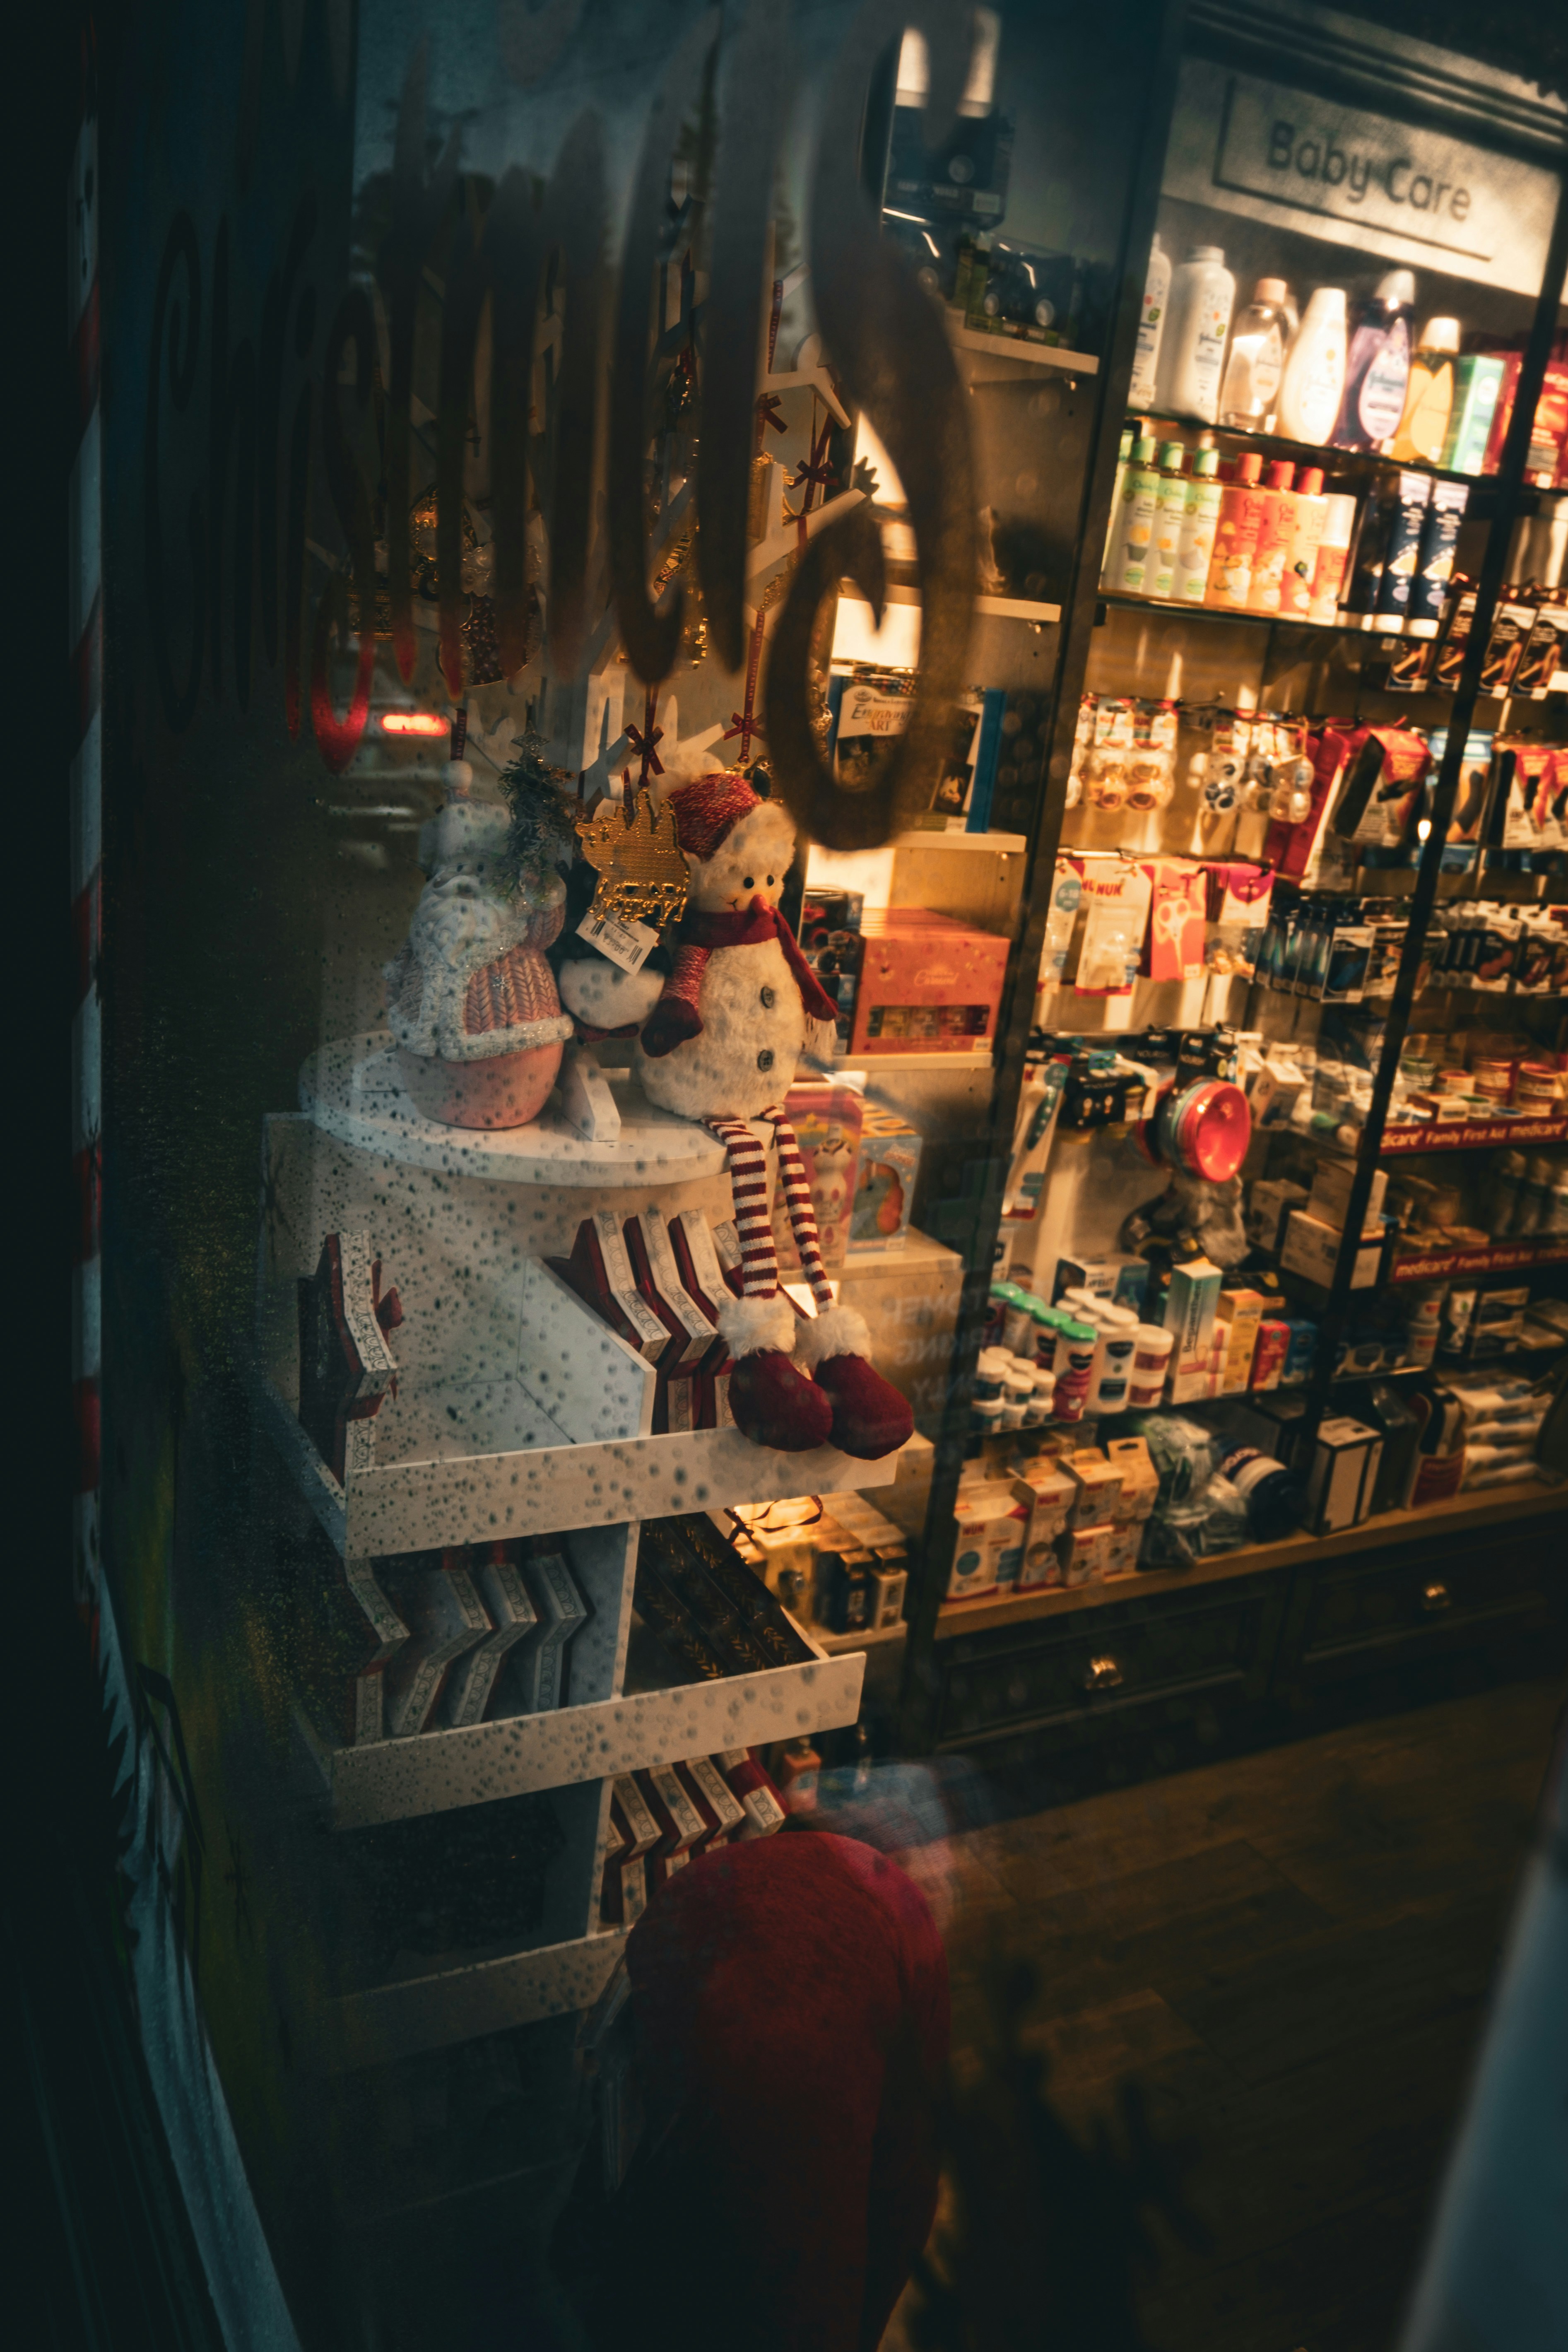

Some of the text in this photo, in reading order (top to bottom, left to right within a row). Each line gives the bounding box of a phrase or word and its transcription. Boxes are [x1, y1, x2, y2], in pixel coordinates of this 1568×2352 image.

[1266, 120, 1471, 222] Baby Care
[748, 659, 758, 701] TIPPERARY
[867, 719, 891, 731] ART
[1096, 883, 1122, 897] NUK
[1182, 1285, 1203, 1353] Bepanthen
